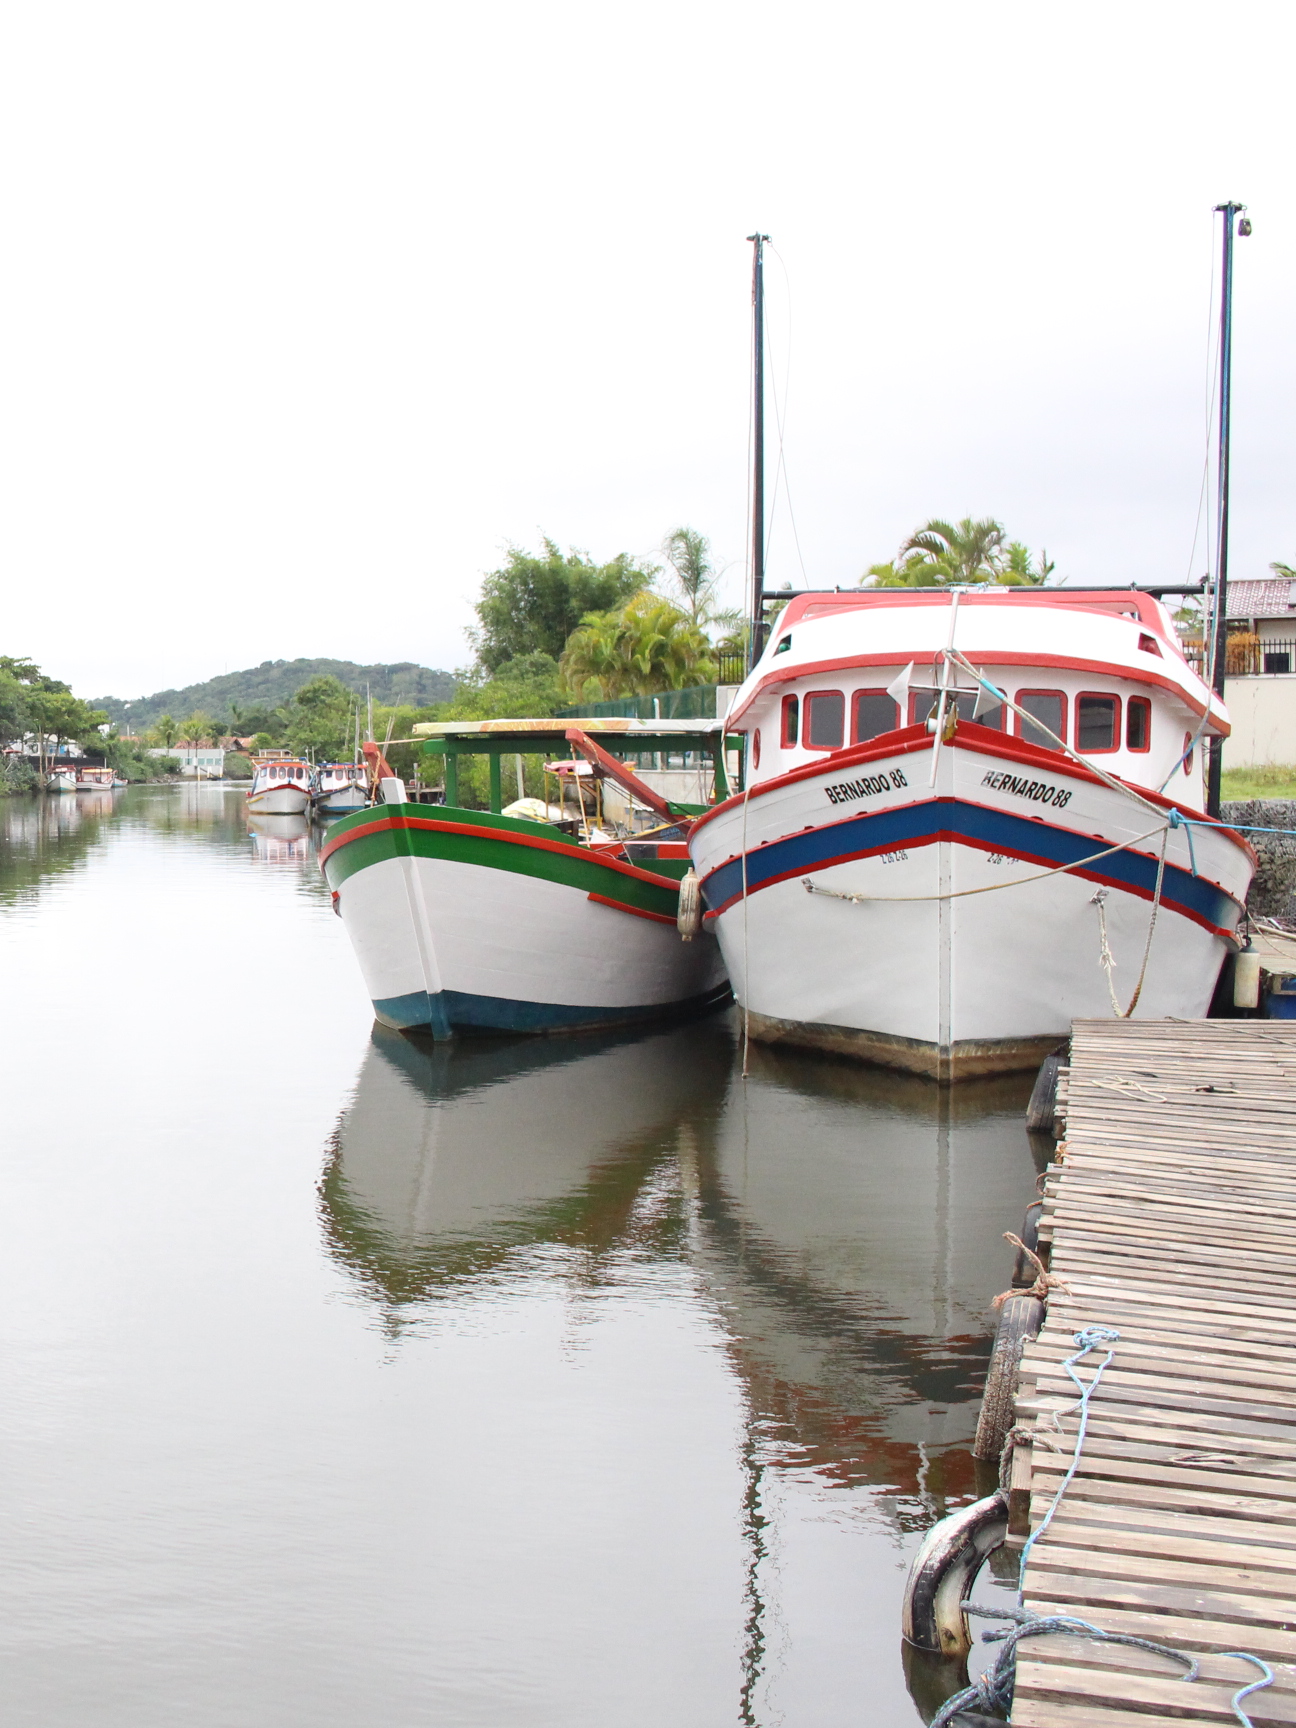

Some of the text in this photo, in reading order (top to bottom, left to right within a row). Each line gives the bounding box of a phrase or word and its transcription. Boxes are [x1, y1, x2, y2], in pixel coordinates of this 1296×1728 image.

[824, 768, 908, 804] BERNARDO 88
[981, 770, 1073, 808] BERNARDO 88
